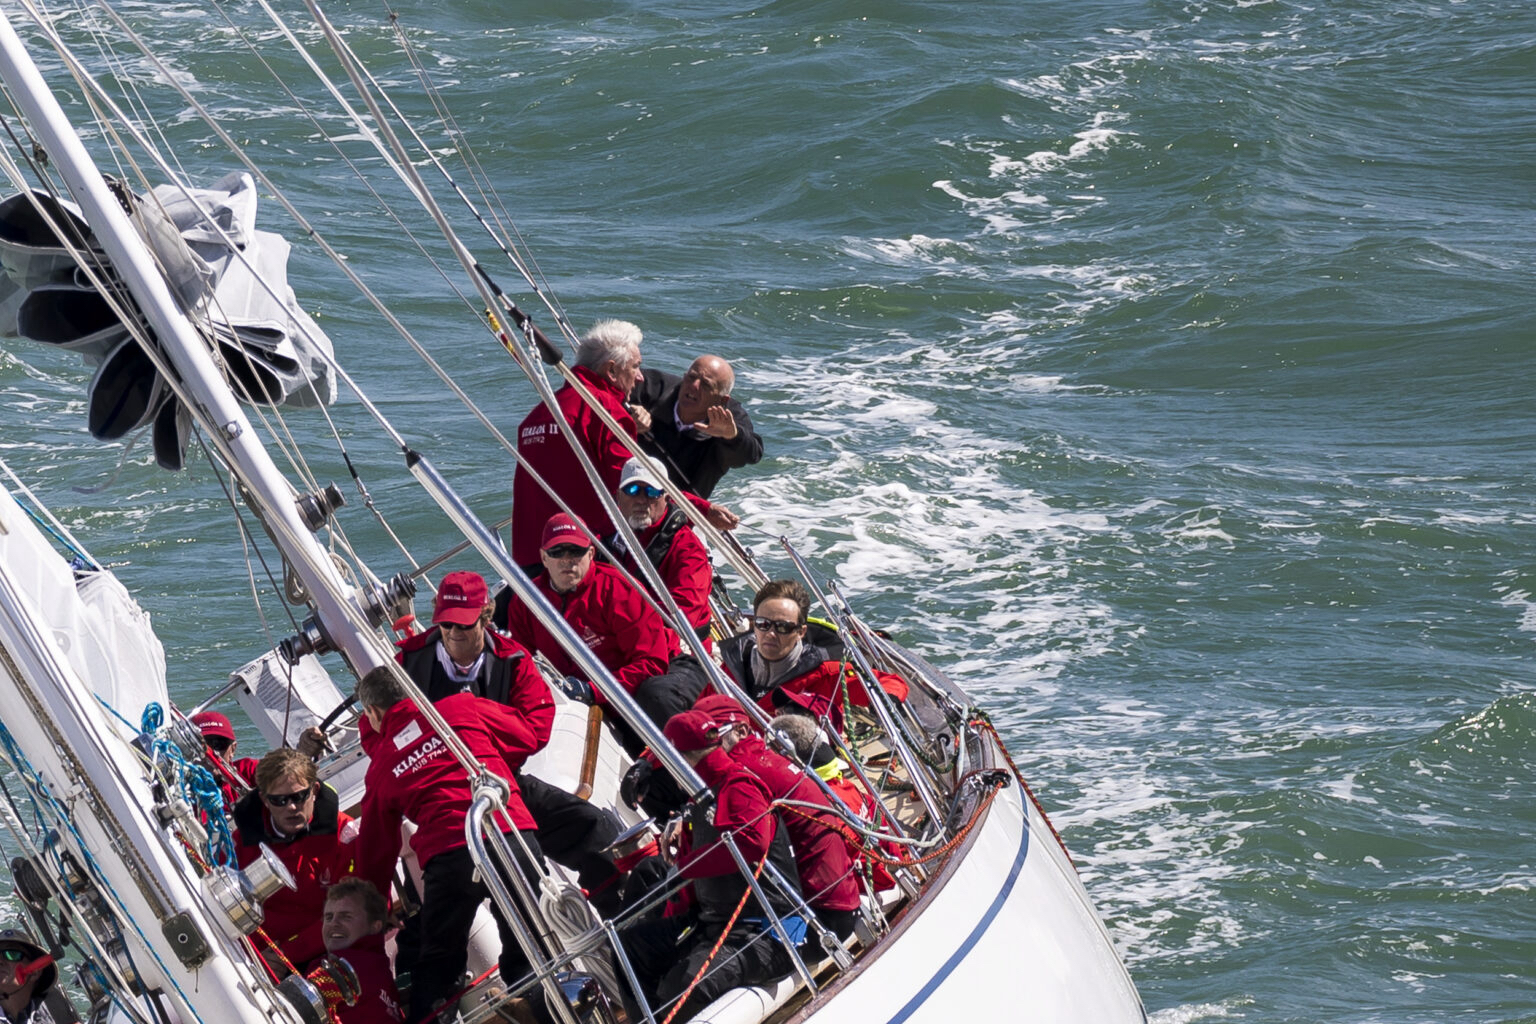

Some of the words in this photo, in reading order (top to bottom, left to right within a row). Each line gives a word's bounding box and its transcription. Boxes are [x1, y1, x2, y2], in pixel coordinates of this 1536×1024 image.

[549, 423, 559, 435] II
[392, 736, 443, 779] KIALOA
[412, 757, 428, 773] AUS
